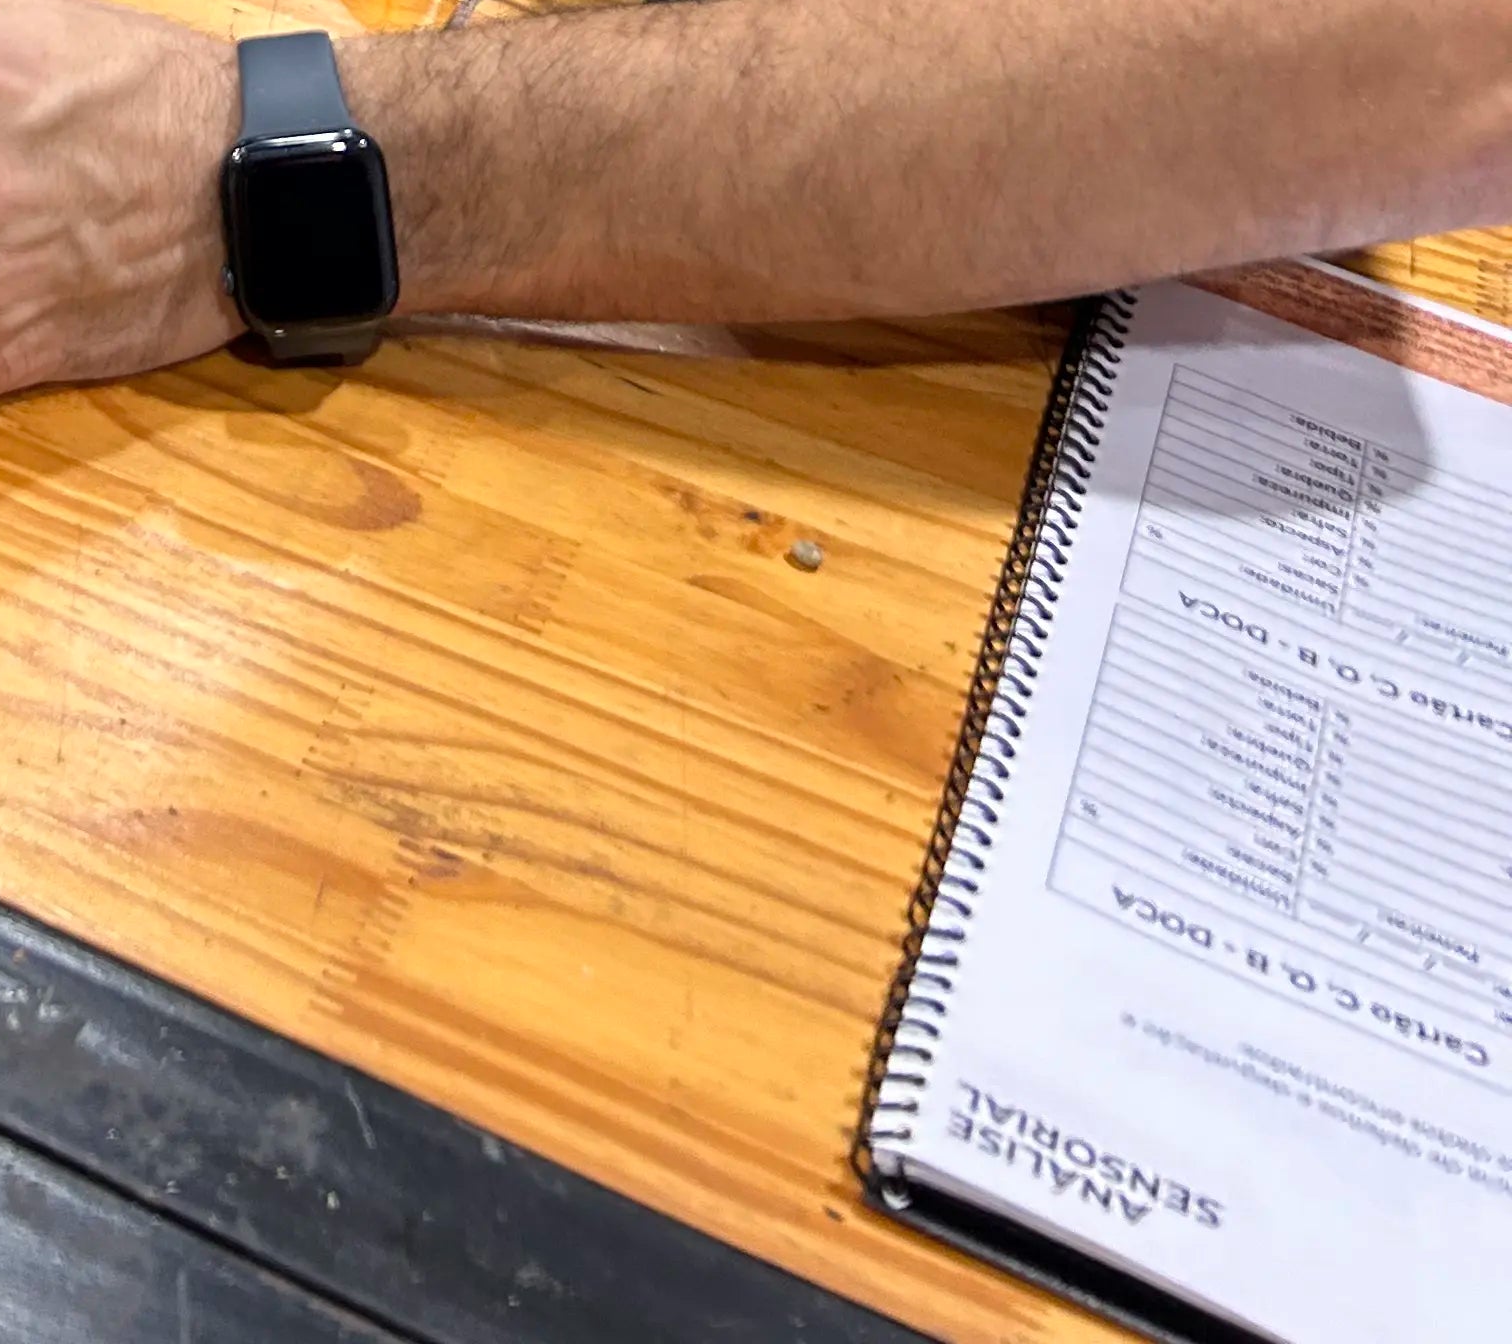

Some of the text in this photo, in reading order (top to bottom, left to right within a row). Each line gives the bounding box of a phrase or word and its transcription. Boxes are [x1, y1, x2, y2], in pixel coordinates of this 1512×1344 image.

[1178, 589, 1268, 644] DOCA
[1298, 645, 1318, 667] B
[1408, 690, 1512, 742] Cartão
[1113, 883, 1213, 949] DOCA
[1369, 1001, 1491, 1068] Cartão
[946, 1108, 1153, 1225] ANÁLISE
[957, 1078, 1225, 1229] SENSORIAL
